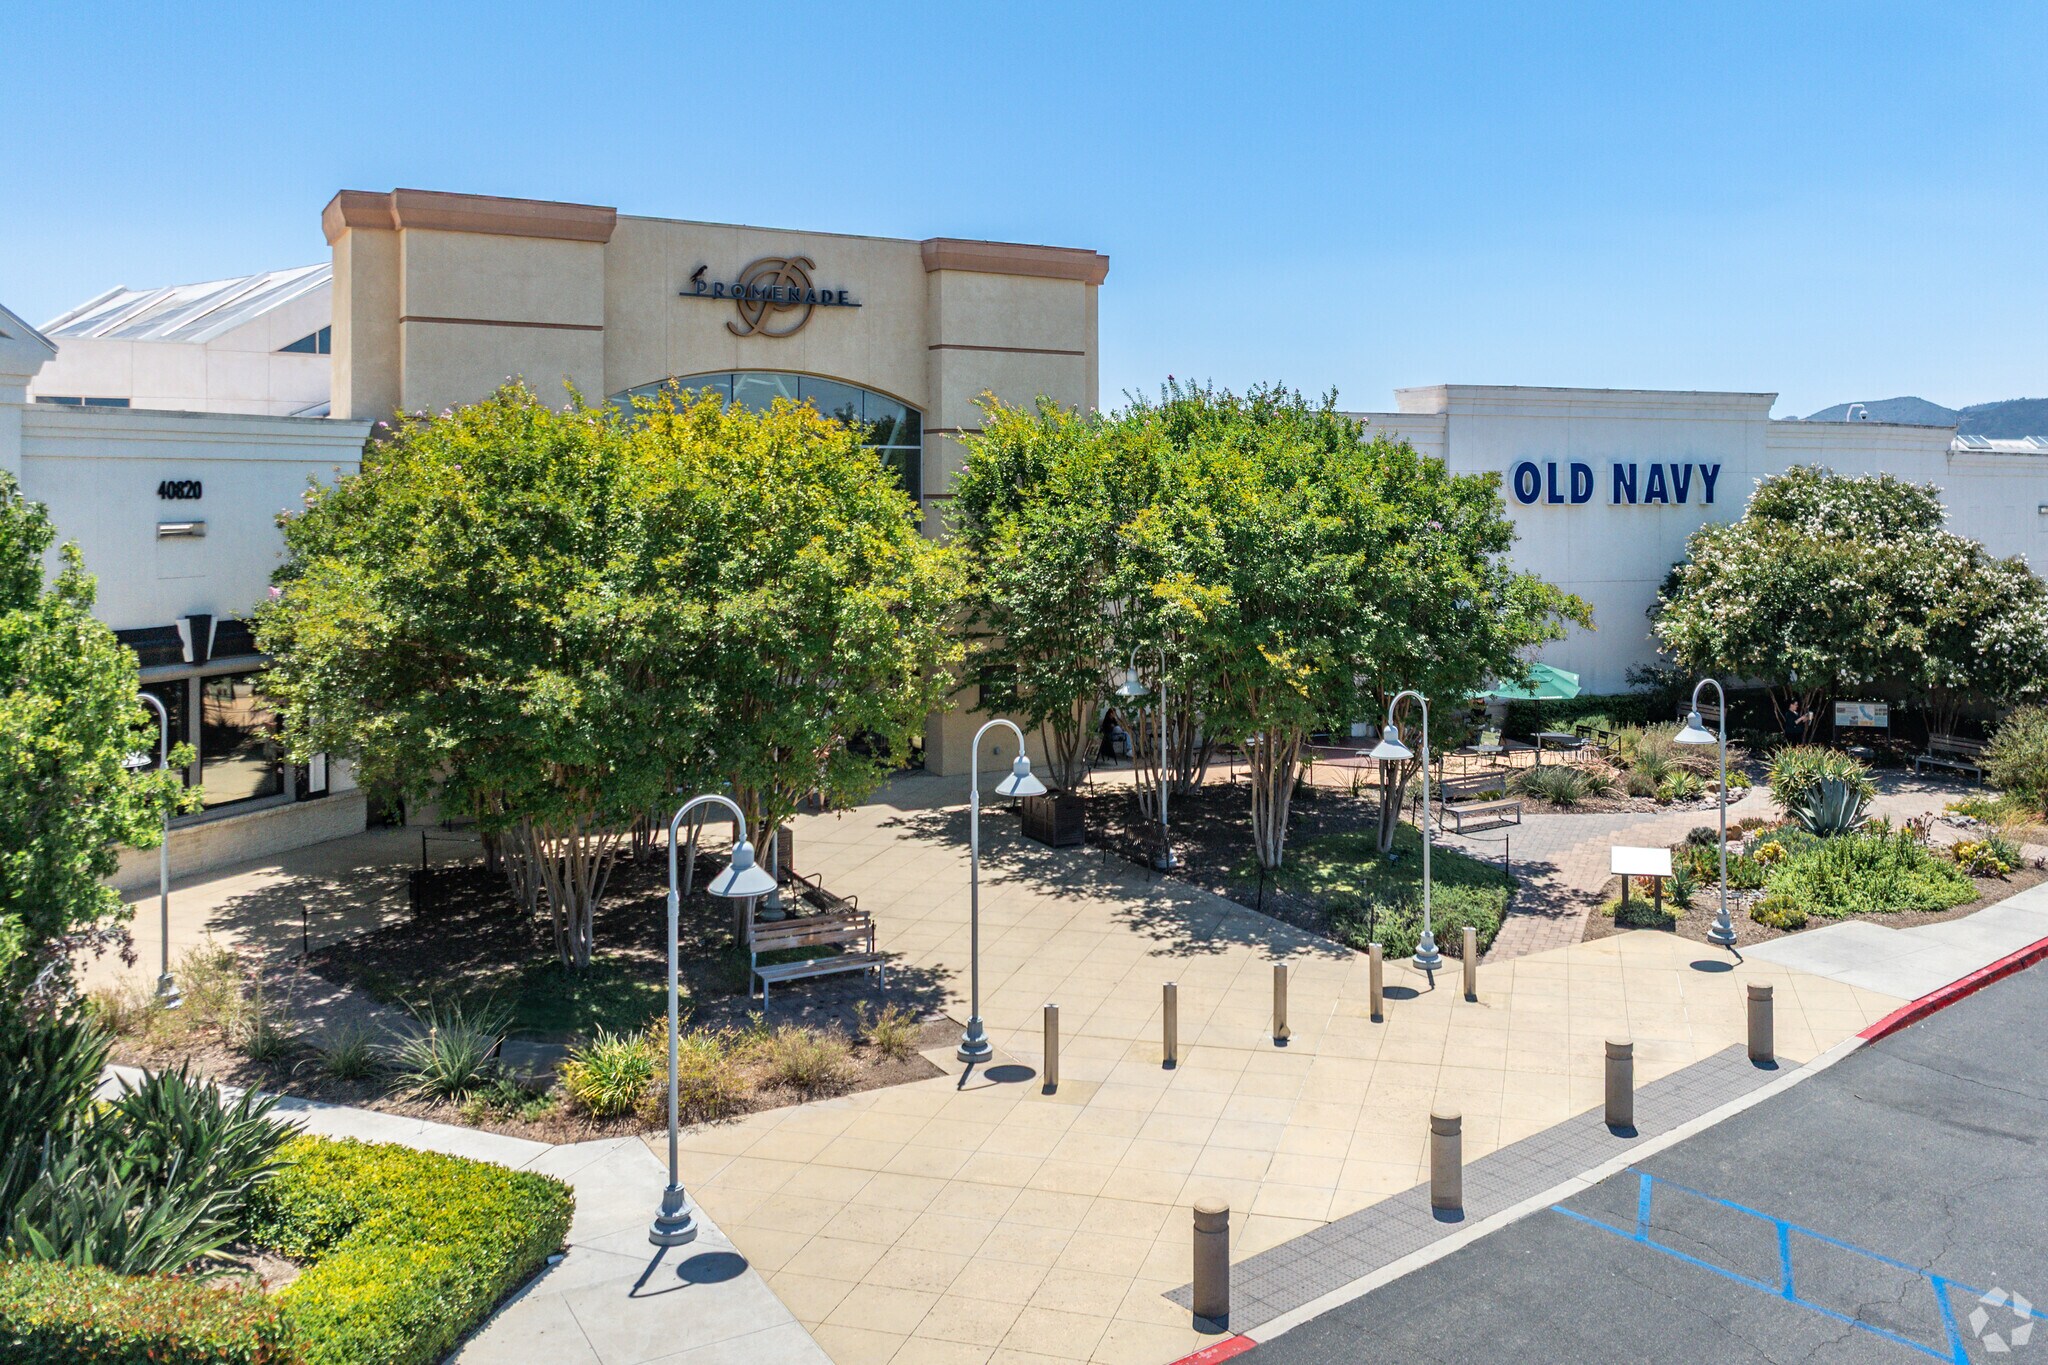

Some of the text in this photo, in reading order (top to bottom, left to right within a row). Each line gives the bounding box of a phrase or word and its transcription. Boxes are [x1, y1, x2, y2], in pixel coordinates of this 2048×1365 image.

[695, 279, 850, 304] PROMENADE
[157, 480, 203, 500] 40820
[1512, 461, 1722, 504] OLD NAVY
